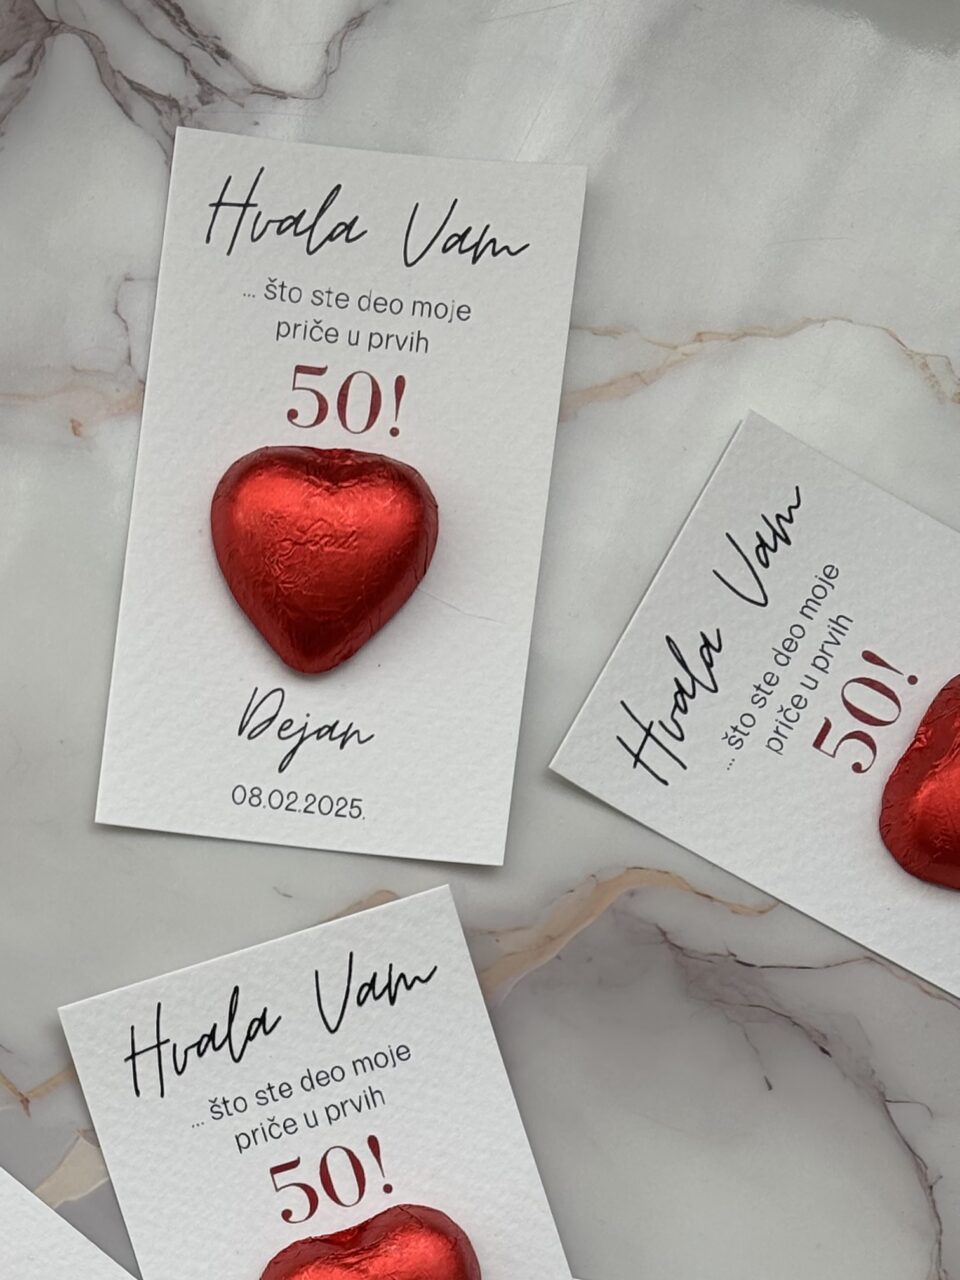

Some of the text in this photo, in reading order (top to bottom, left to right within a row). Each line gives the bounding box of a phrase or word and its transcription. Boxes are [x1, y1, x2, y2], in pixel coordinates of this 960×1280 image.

[205, 166, 530, 268] Hvala Vam
[264, 277, 302, 304] što
[311, 287, 349, 309] ste
[358, 290, 403, 315] deo
[411, 300, 471, 323] moje
[276, 319, 428, 353] priče u prvih
[287, 364, 406, 437] 50!
[616, 485, 801, 786] Hvala Vam
[721, 713, 756, 750] što
[751, 672, 779, 709] ste
[772, 624, 806, 667] deo
[799, 564, 839, 620] moje
[765, 615, 853, 755] priče u prvih
[812, 650, 918, 774] 50!
[238, 686, 375, 774] Dejan
[232, 784, 365, 820] 08.02.2025.
[124, 951, 438, 1099] Hvala Vam
[208, 1096, 248, 1120] što
[255, 1082, 293, 1106] ste
[300, 1065, 345, 1092] deo
[352, 1044, 411, 1076] moje
[235, 1085, 385, 1154] priče u prvih
[269, 1135, 393, 1224] 50!
